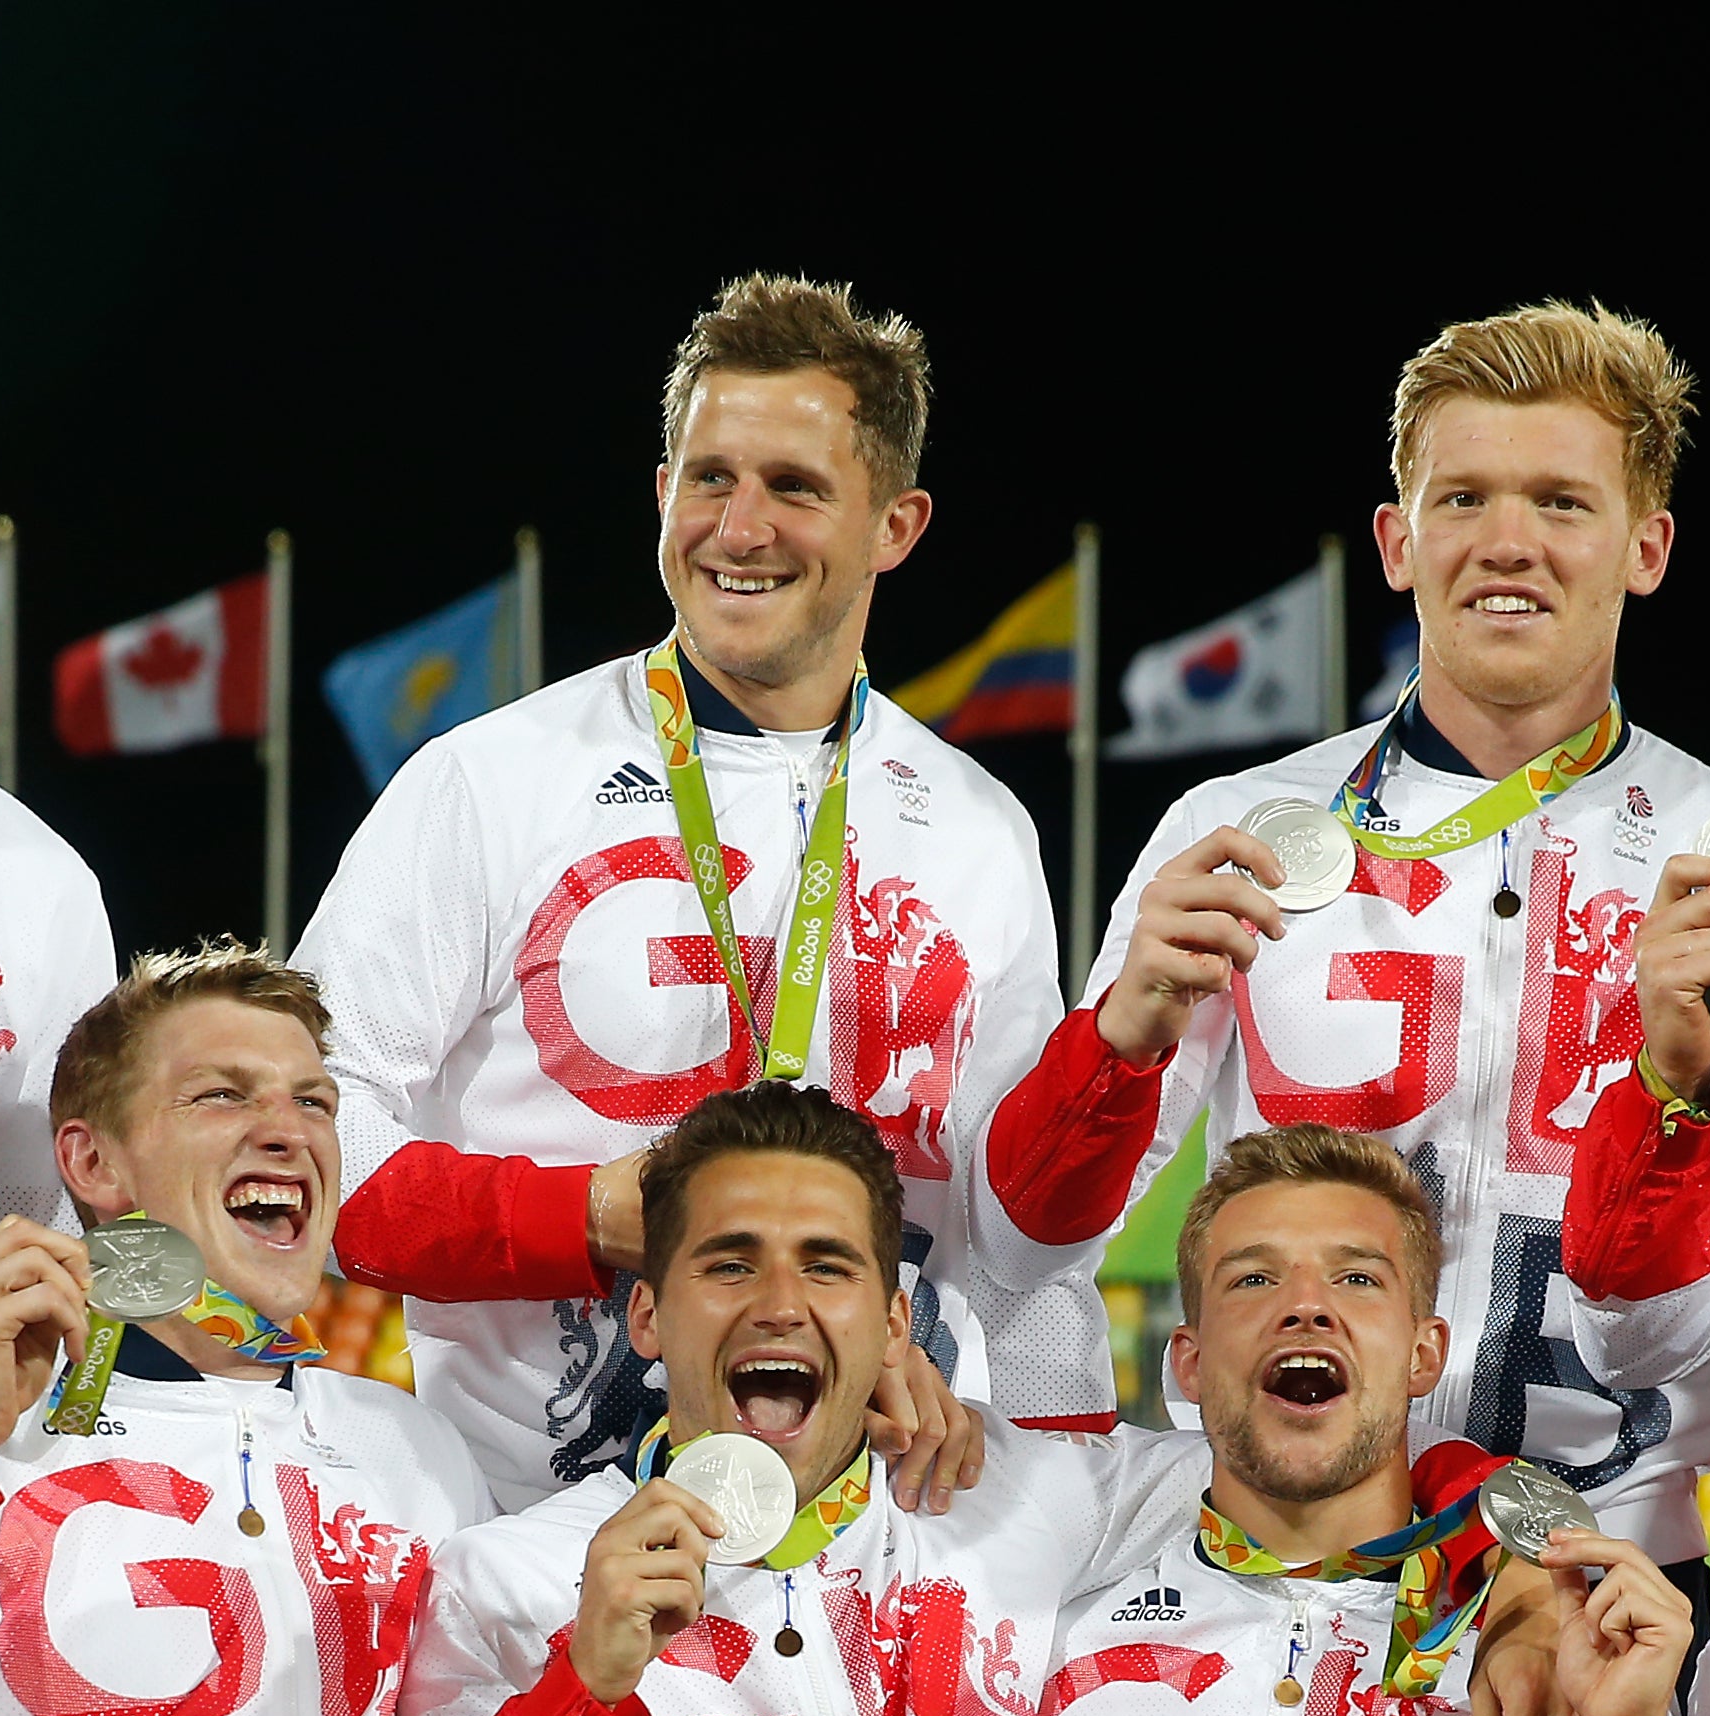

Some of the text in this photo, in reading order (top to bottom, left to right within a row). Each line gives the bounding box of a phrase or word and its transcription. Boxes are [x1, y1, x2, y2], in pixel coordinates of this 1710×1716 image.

[885, 776, 932, 795] TEAM GB
[1613, 808, 1658, 838] TEAM GB
[1611, 847, 1649, 865] Rio2016
[792, 916, 823, 987] Rio2016
[76, 1326, 114, 1391] Rio2016
[1110, 1604, 1187, 1622] adidas
